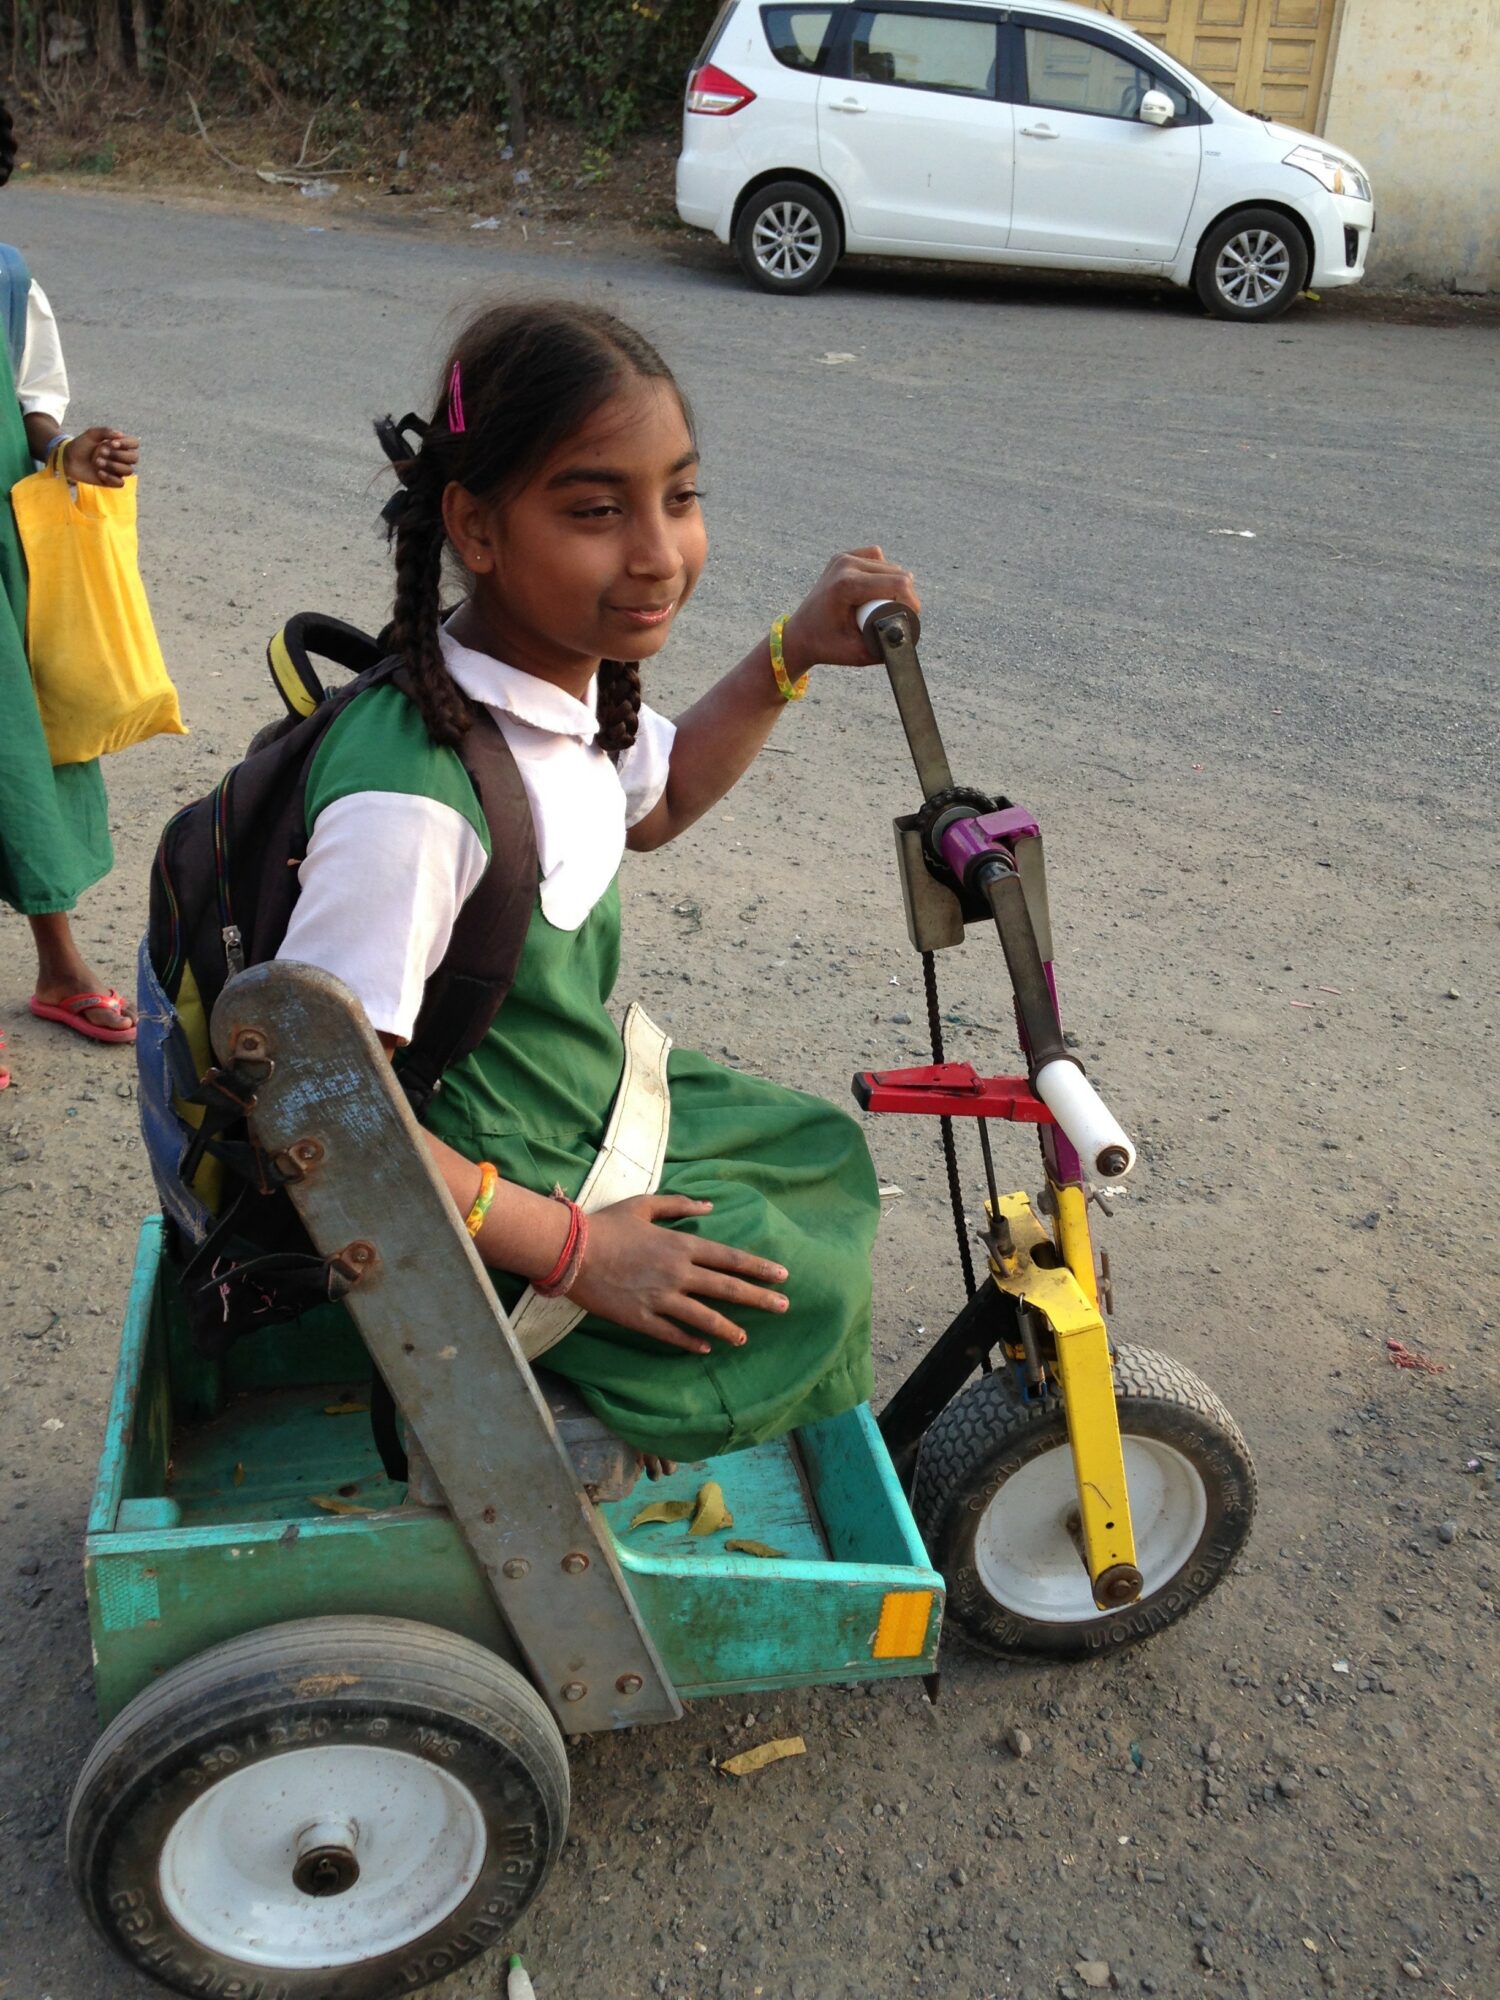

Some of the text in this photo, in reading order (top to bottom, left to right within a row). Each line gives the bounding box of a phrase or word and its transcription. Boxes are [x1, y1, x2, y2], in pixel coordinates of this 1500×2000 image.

[1085, 1543, 1232, 1648] marathon
[410, 1725, 464, 1759] NHS
[401, 1822, 537, 1986] marathon
